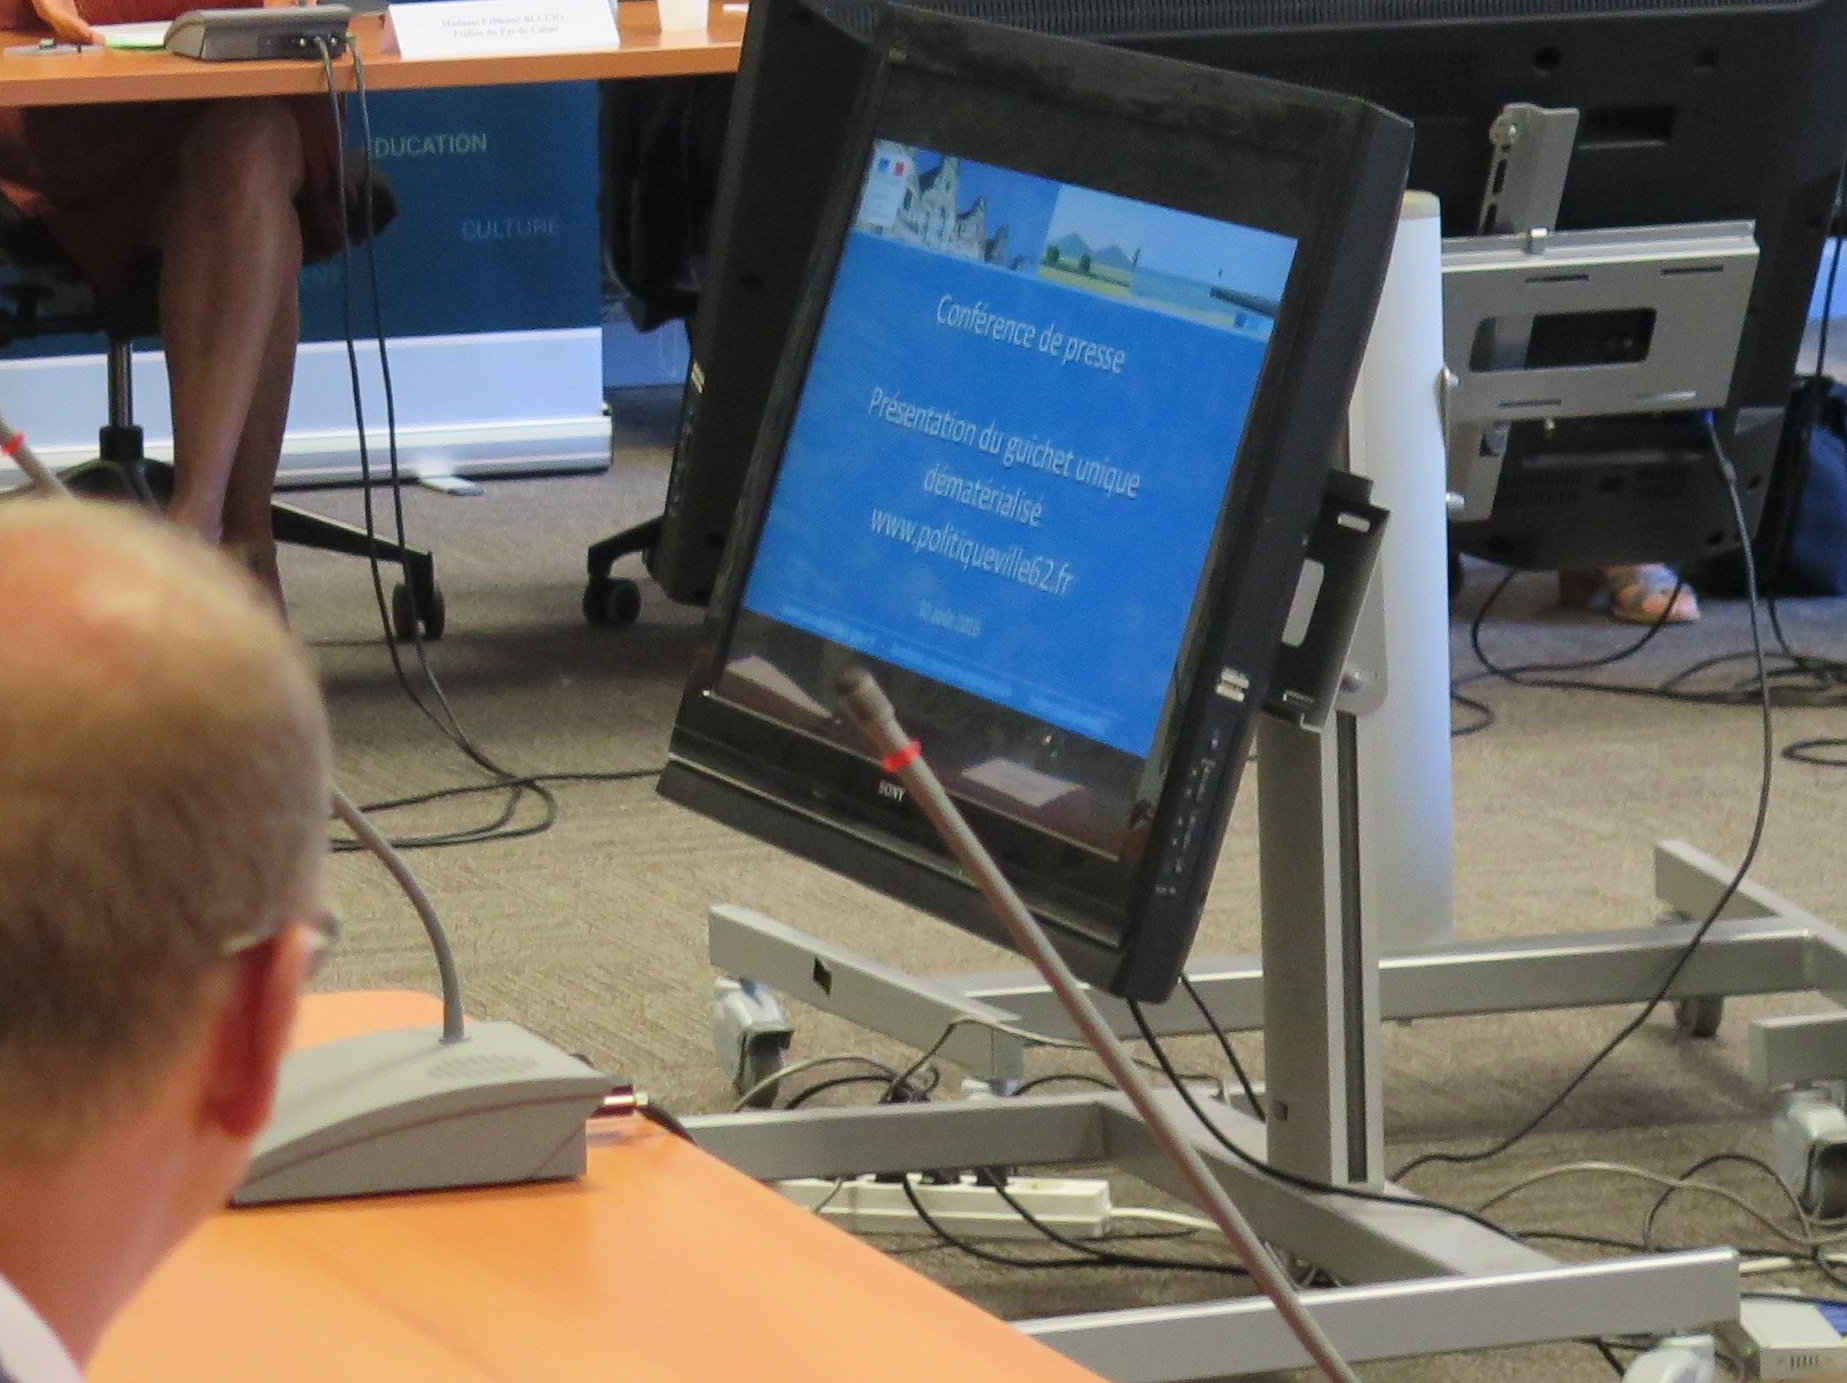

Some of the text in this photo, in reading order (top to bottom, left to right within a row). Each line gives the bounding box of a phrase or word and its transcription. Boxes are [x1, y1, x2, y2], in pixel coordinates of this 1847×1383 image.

[461, 218, 558, 241] CULTURE
[936, 293, 1125, 376] Conférence de presse
[868, 386, 1142, 500] Présentation du guichet unique
[923, 462, 1045, 529] dématérialisé
